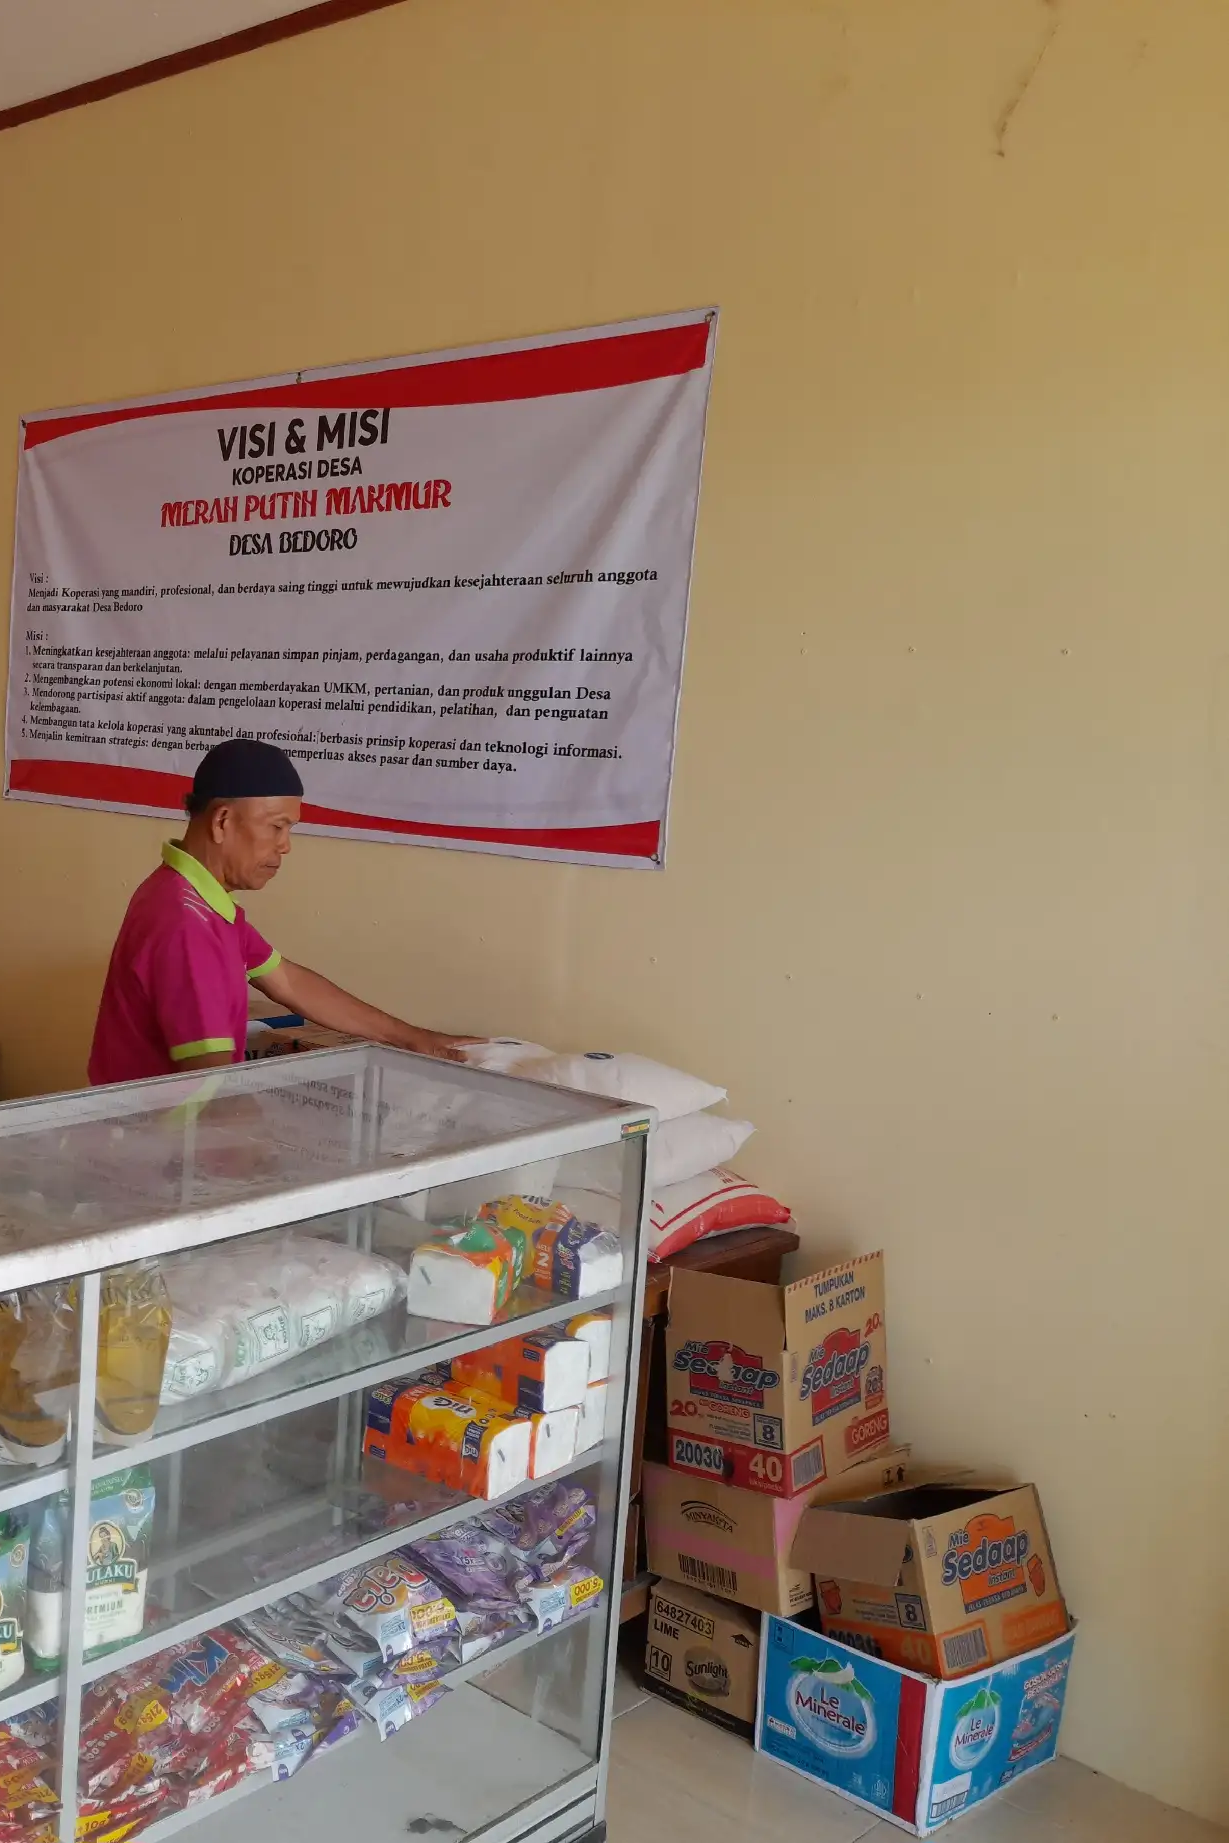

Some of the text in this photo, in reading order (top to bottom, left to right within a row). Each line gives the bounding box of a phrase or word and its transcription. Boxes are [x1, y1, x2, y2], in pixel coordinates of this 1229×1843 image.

[217, 408, 391, 461] VISI & MISI
[232, 456, 362, 485] KOPERASI DESA
[160, 479, 452, 527] MERAH PUTIH MAKMUR
[229, 527, 357, 556] DESA BEDORO
[28, 568, 658, 600] Menjadi Koperasi yang mandiri, profesional, dan berdaya saing tinggi untuk mewujudkan kesejahteraan seluruh anggota
[30, 573, 43, 583] Visi
[26, 631, 43, 640] Misi
[33, 646, 633, 664] Meningkatkan kesejahteraan anggota: melalui pelayanan simpan pinjam, perdagangan, dan usaha produktif lainnya
[33, 673, 611, 701] Mengembangkan potensi ekonomi lokal: dengan memberdayakan UMKM, pertanian, dan produk unggulan Desa
[32, 688, 608, 721] Mendorong partisipasi aktif anggota: dalam pengelolaan koperasi melalui pendidikan, pelatihan, dan penguatan
[30, 715, 622, 759] Membangun tata kelola koperasi yang akuntabel dan profesional: berbasis prinsip koperasi dan teknologi informasi.
[813, 1271, 854, 1299] TUMPUKAN
[805, 1286, 865, 1323] MAKS. 8 KARTON
[684, 1340, 709, 1354] Mie
[808, 1344, 825, 1362] Mie
[799, 1341, 871, 1399] Sedaap
[670, 1400, 750, 1418] 20 GORENG
[762, 1425, 775, 1441] 8
[851, 1414, 888, 1445] GORENG
[675, 1439, 783, 1483] 20030 40
[949, 1529, 970, 1550] Mie
[941, 1530, 1030, 1586] Sedaap
[85, 1564, 133, 1583] ULAKU
[86, 1600, 123, 1615] REMIUM
[656, 1598, 713, 1635] 64827403
[904, 1606, 917, 1623] 8
[654, 1618, 680, 1640] LIME
[652, 1650, 670, 1672] 10
[685, 1660, 728, 1679] Sunlight
[820, 1688, 839, 1709] Le
[795, 1691, 866, 1736] Minerale
[971, 1718, 981, 1732] Le
[955, 1725, 994, 1748] Minerale
